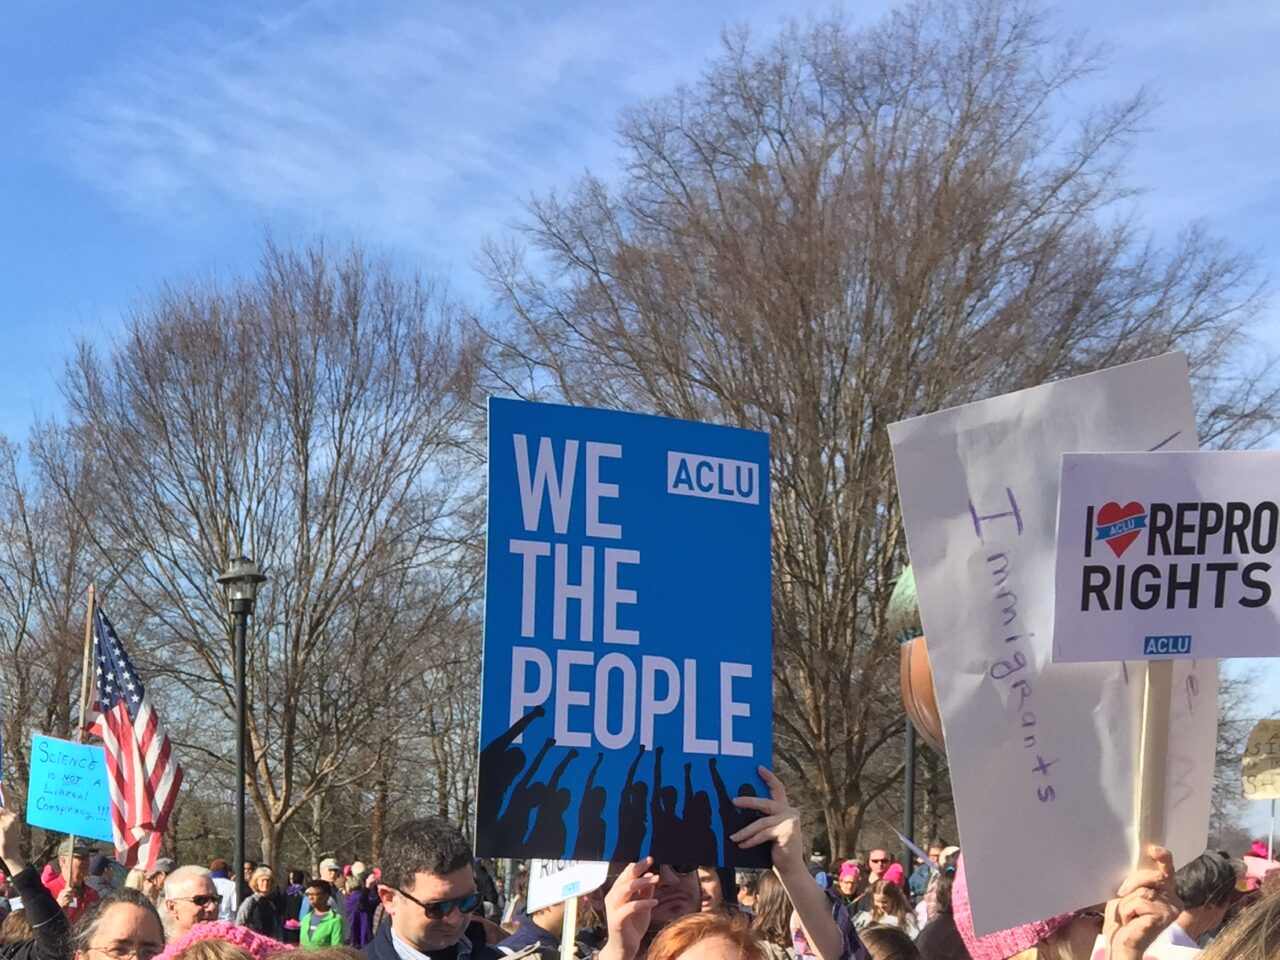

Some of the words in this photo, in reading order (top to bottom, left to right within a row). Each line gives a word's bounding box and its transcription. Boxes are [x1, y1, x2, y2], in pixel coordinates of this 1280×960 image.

[513, 434, 622, 539] WE
[672, 457, 754, 498] ACLU
[1085, 506, 1094, 557] I
[1147, 502, 1279, 555] REPRO
[1110, 520, 1134, 535] ACLU
[510, 539, 640, 645] THE
[1081, 562, 1272, 611] RIGHTS
[1146, 638, 1188, 653] ACLU
[509, 646, 753, 757] PEOPLE
[63, 774, 82, 783] NOT
